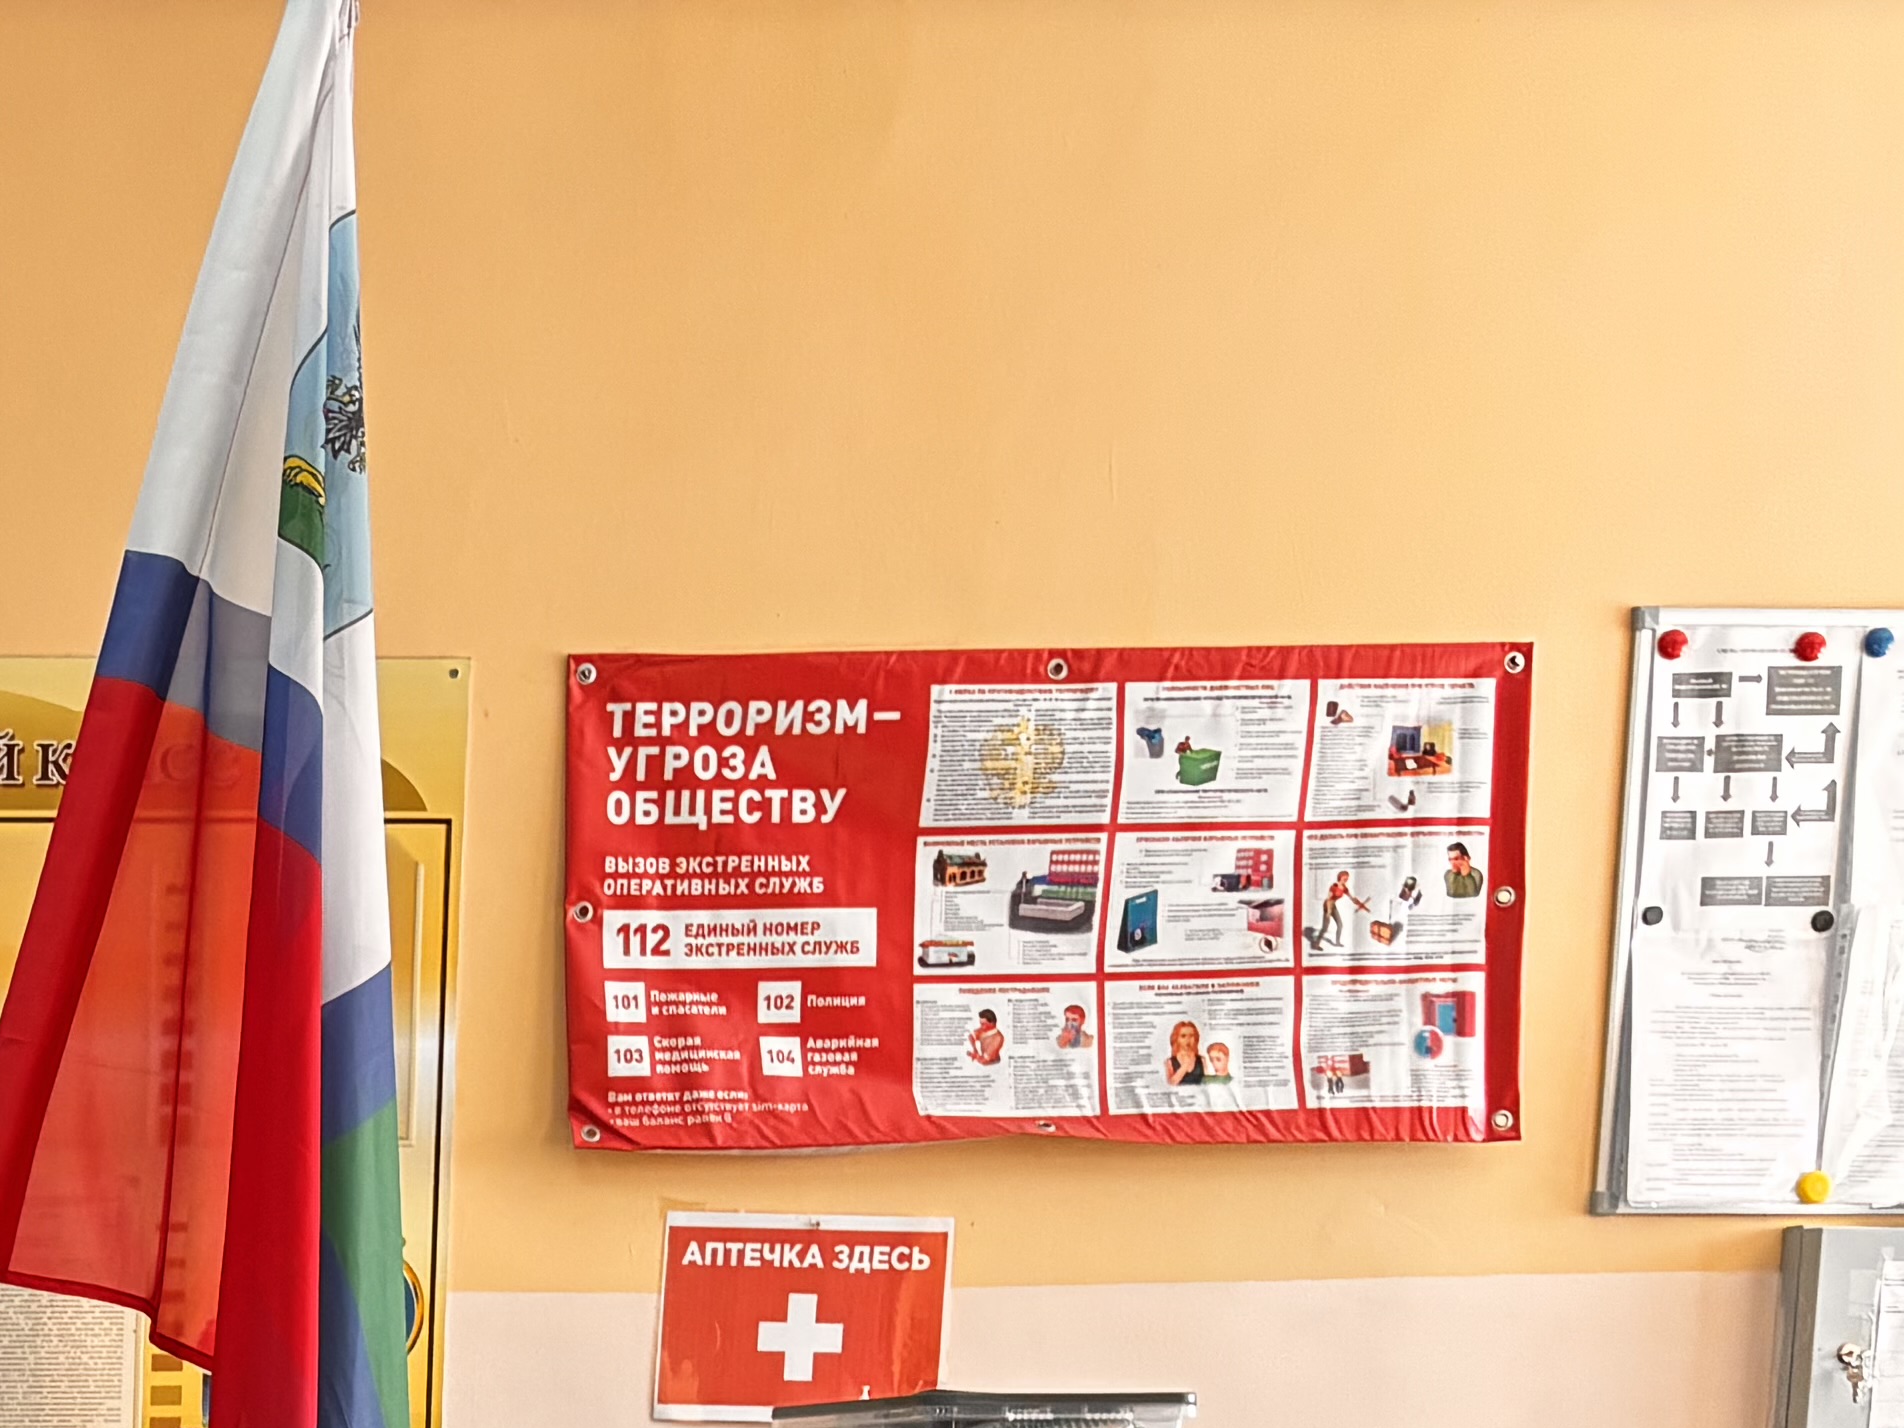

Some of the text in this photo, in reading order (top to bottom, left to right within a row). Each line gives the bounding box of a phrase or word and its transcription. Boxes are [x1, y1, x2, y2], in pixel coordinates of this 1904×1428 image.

[607, 744, 777, 782] УГРОЗА
[606, 788, 847, 830] ОБЩЕСТВУ
[604, 855, 810, 874] ВЫЗОВ ЭКСТРЕННЫХ
[603, 877, 824, 897] ОПЕРАТИВНЫХ СЛУЖБ
[684, 920, 821, 940] ЕДИНЫЙ НОМЕР
[616, 923, 671, 957] 112
[683, 940, 860, 958] ЭКСТРЕННЫХ СЛУЖБ
[612, 994, 639, 1010] 101
[650, 990, 719, 1003] Пожарные
[763, 994, 866, 1010] 102 Полиция
[662, 1004, 727, 1015] спасатели
[653, 1036, 701, 1048] Скорая
[807, 1035, 879, 1049] Аварийная
[613, 1049, 643, 1064] 103
[767, 1049, 794, 1064] 104
[807, 1052, 858, 1062] газовая
[807, 1063, 854, 1077] служба
[682, 1240, 931, 1273] АПТЕЧКА ЗДЕСЬ
